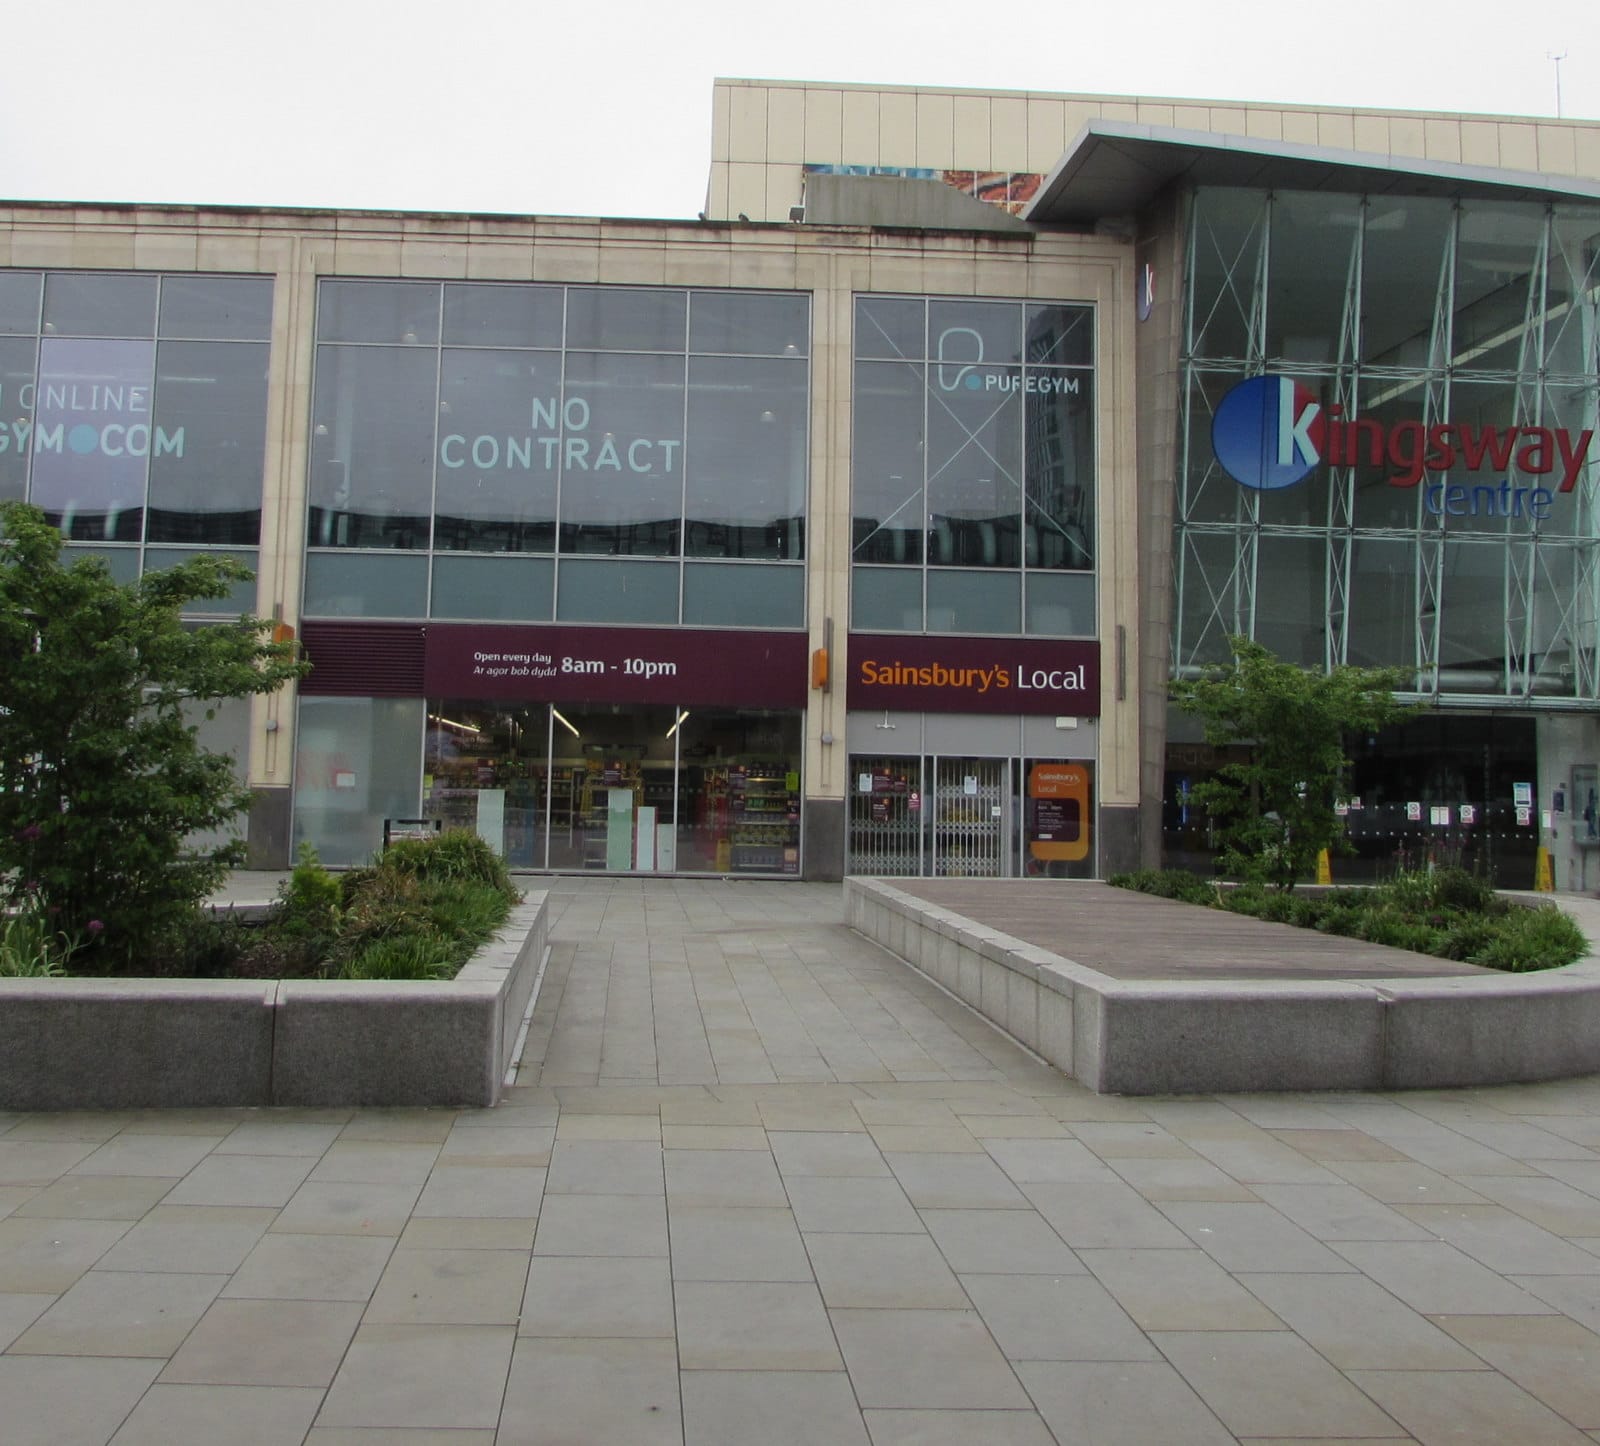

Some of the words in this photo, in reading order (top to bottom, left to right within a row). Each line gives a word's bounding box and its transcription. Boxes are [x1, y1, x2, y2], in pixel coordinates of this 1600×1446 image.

[19, 383, 149, 412] ONLINE
[985, 374, 1080, 395] PUREGYM
[531, 396, 591, 431] NO
[440, 434, 681, 473] CONTRACT
[1425, 479, 1554, 520] centre
[473, 651, 501, 663] Open
[502, 653, 531, 664] every
[532, 653, 552, 664] day
[473, 665, 485, 675] Ar
[486, 667, 509, 678] agor
[511, 666, 530, 676] bob
[531, 667, 558, 678] dydd
[561, 656, 605, 674] 8am
[623, 657, 677, 679] 10pm
[861, 660, 1010, 693] Sainsbury's
[1017, 665, 1087, 690] Local
